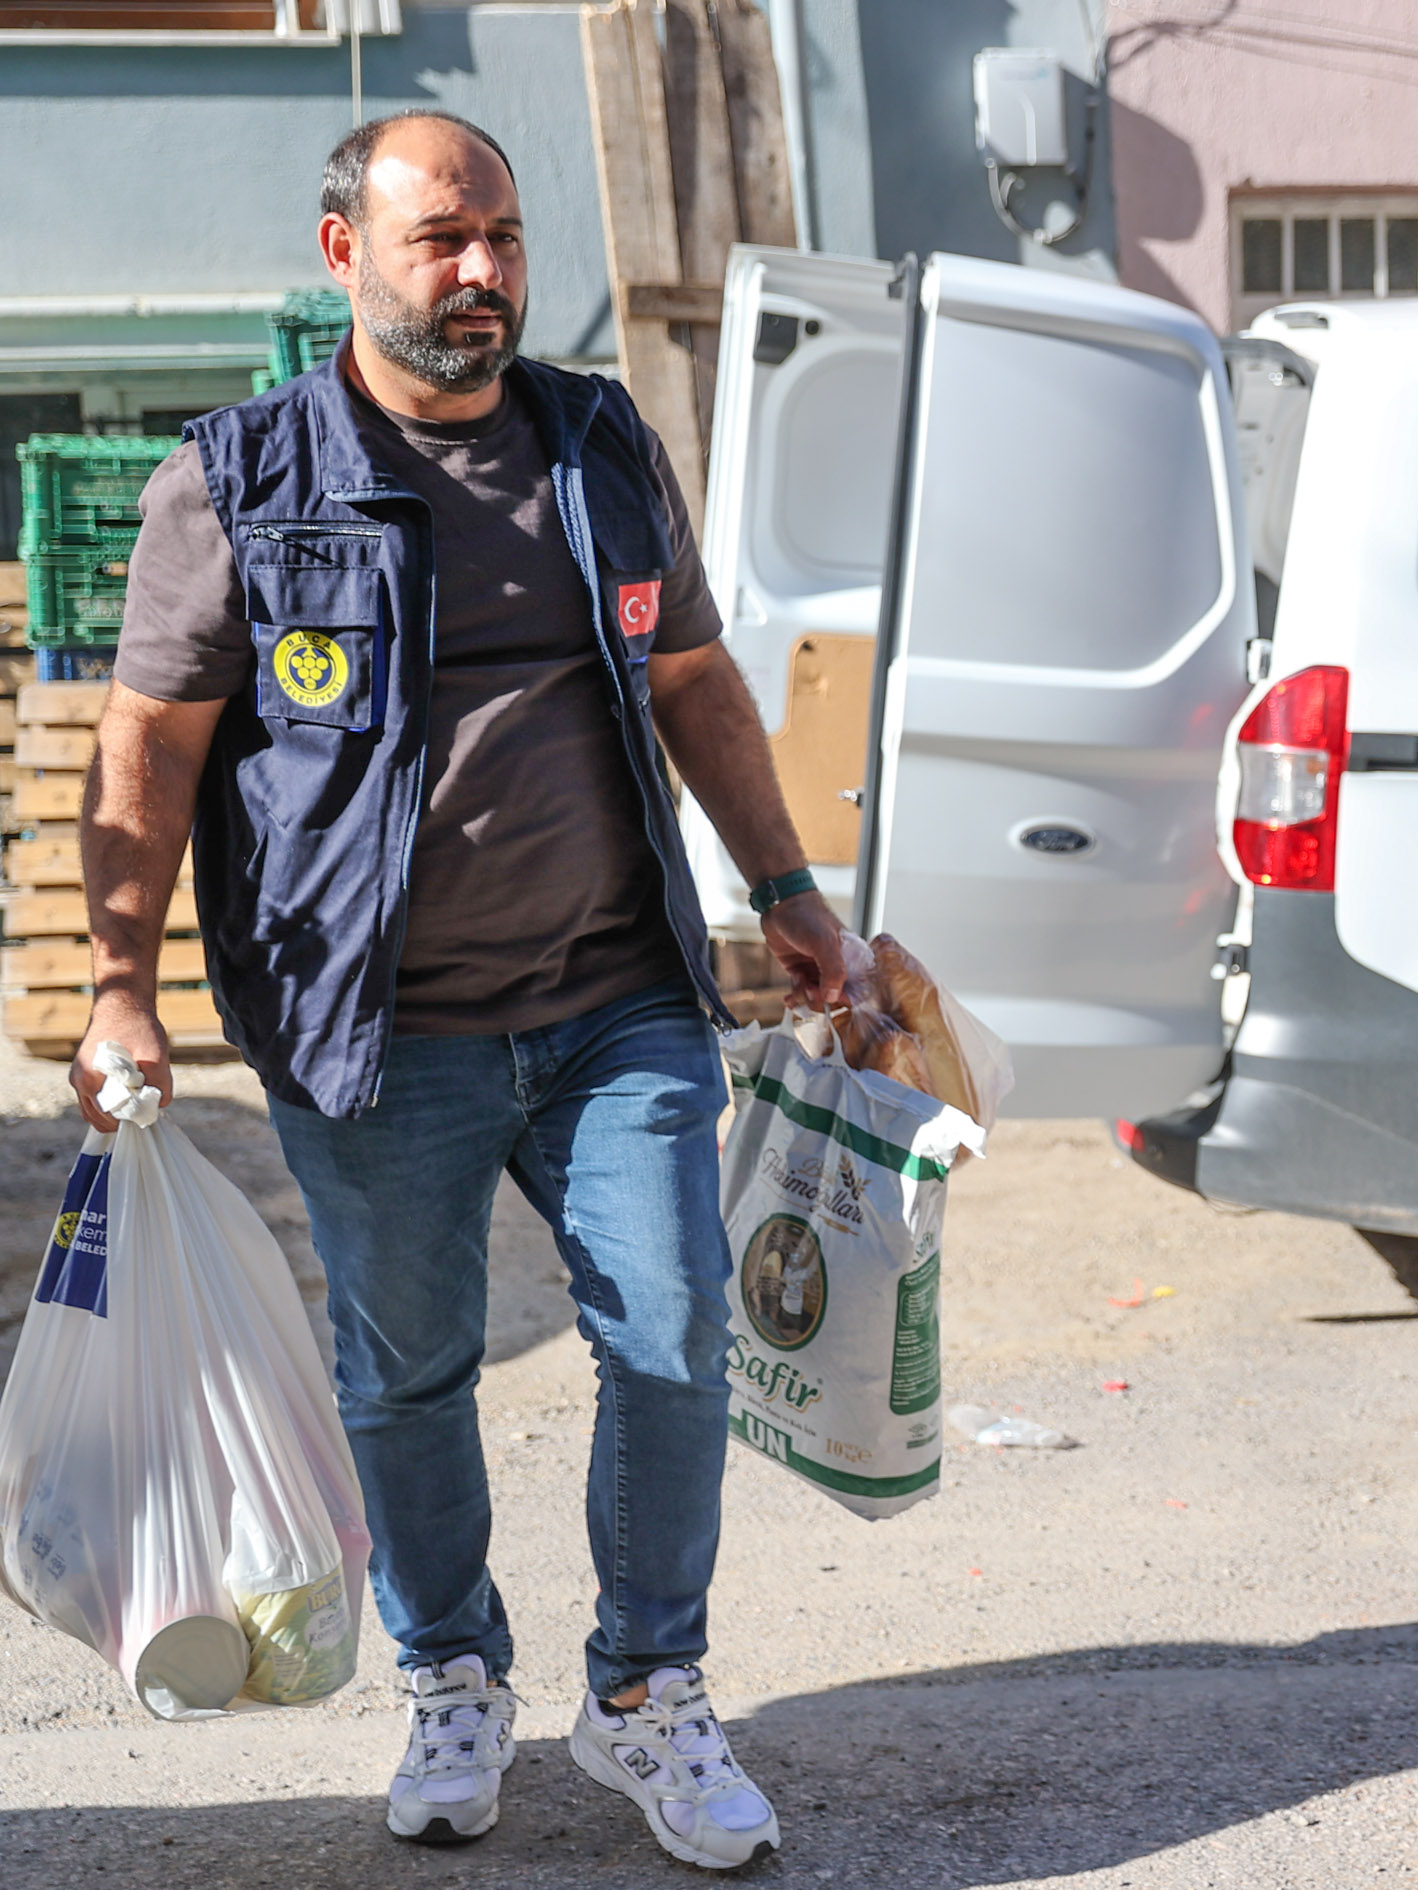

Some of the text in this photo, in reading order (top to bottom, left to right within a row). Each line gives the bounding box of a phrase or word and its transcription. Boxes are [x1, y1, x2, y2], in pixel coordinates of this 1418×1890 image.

[286, 633, 331, 649] BUCA
[728, 1334, 820, 1410] Safir
[746, 1411, 788, 1463] UN
[826, 1438, 842, 1457] 10
[624, 1747, 660, 1780] N
